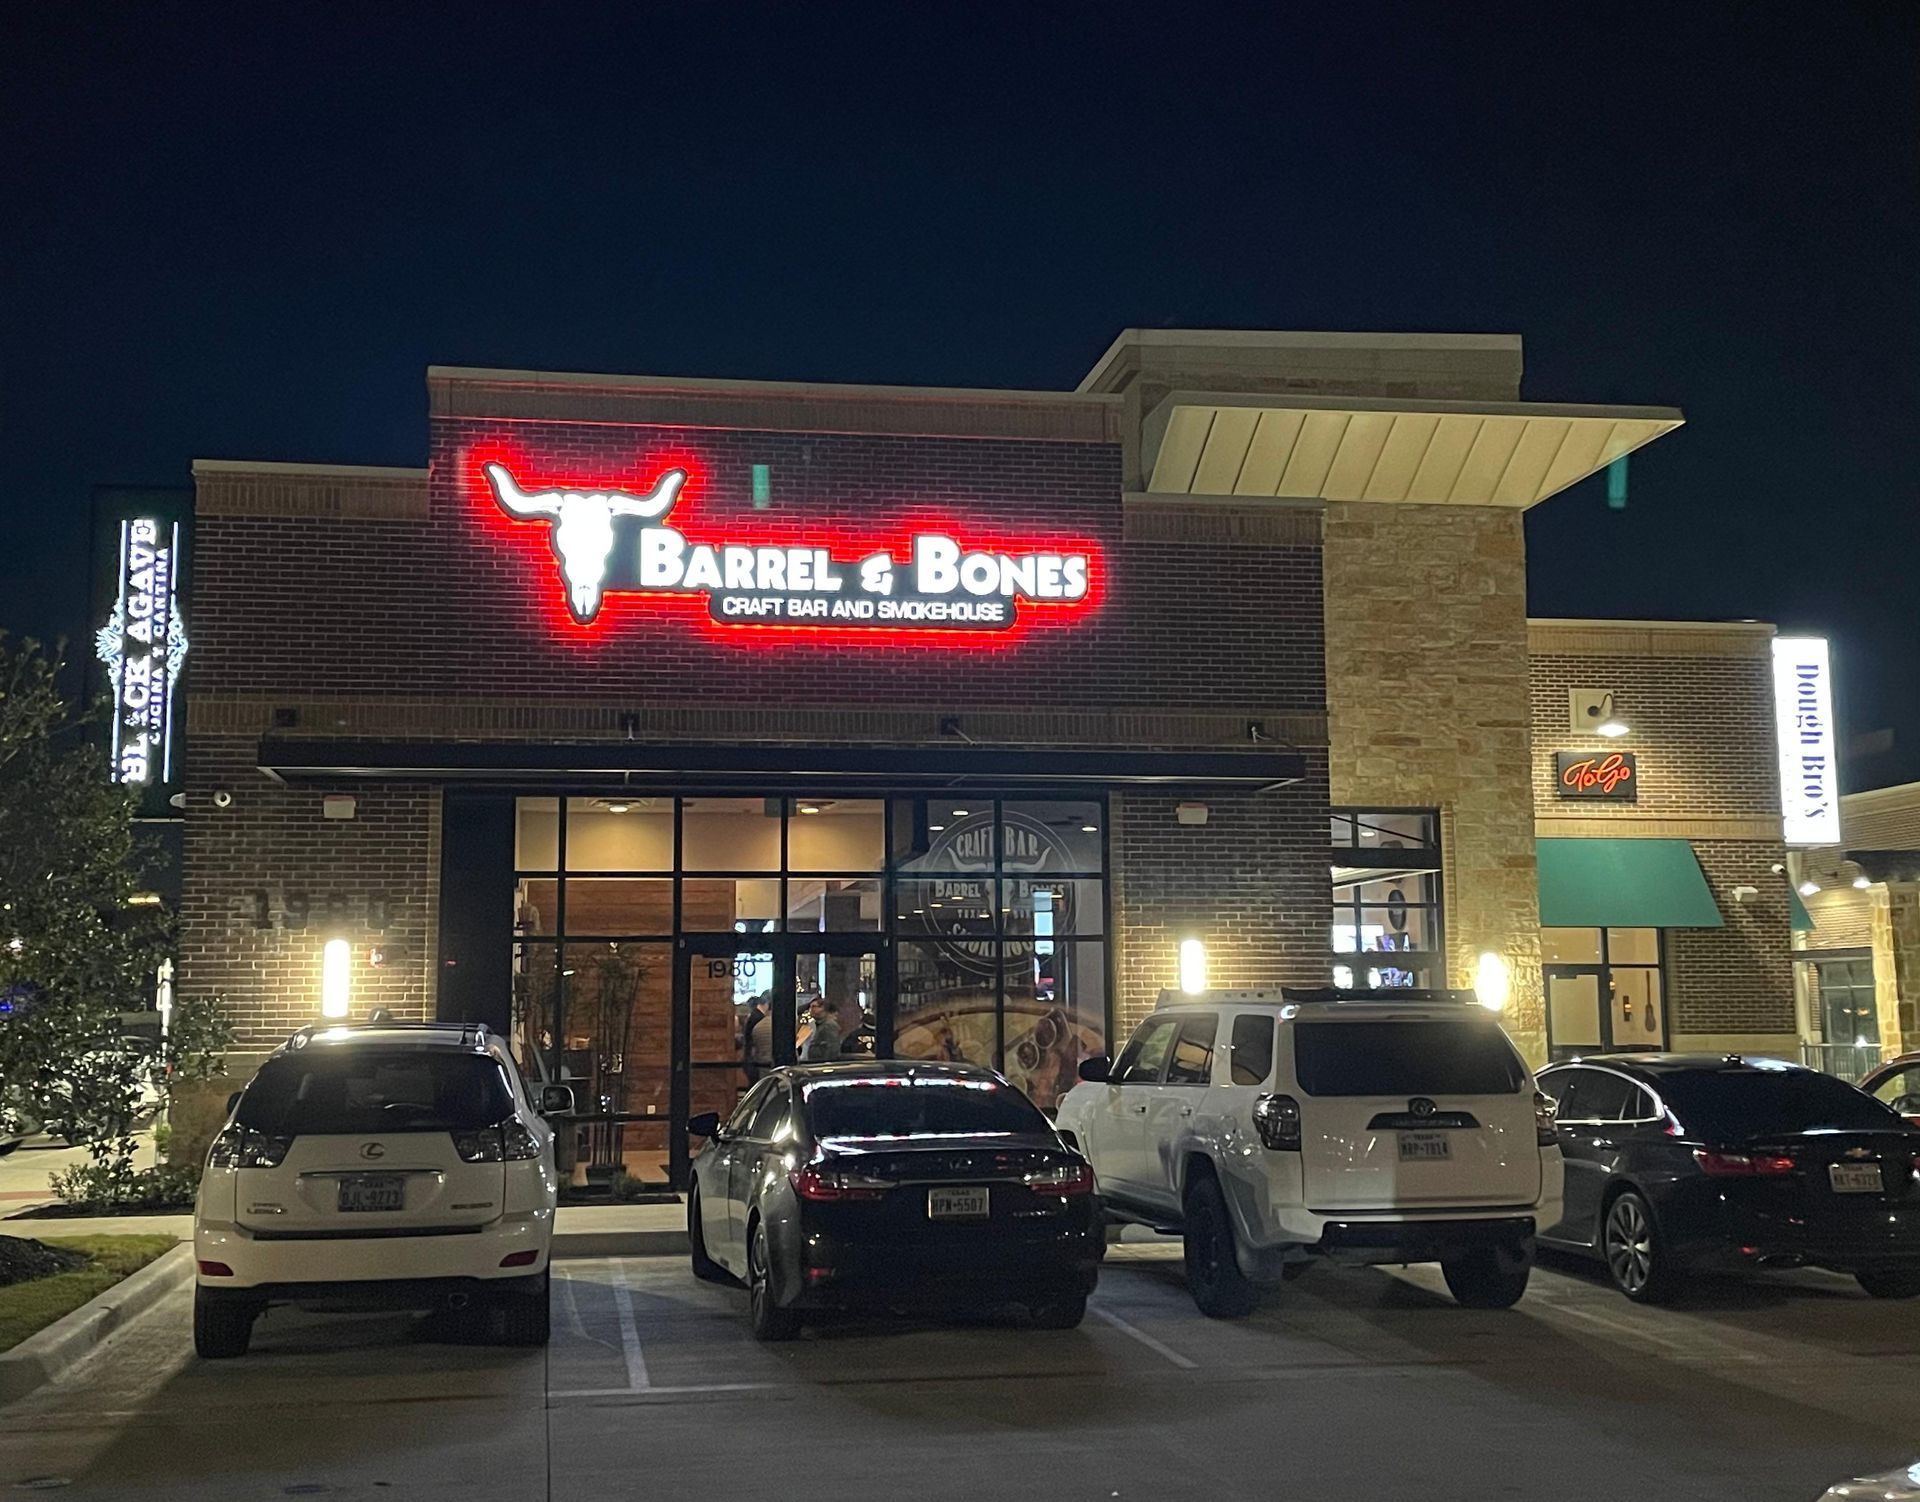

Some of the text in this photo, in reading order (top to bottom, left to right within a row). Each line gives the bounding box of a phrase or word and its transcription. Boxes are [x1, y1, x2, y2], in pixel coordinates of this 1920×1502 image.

[126, 519, 156, 644] AGAVE
[640, 527, 1087, 600] BARREL & BONES
[152, 548, 168, 637] CANTINA
[723, 597, 1004, 621] CRAFT BAR AND SMOKEHOUSE
[1004, 826, 1039, 857] BAR
[707, 960, 756, 978] 1980
